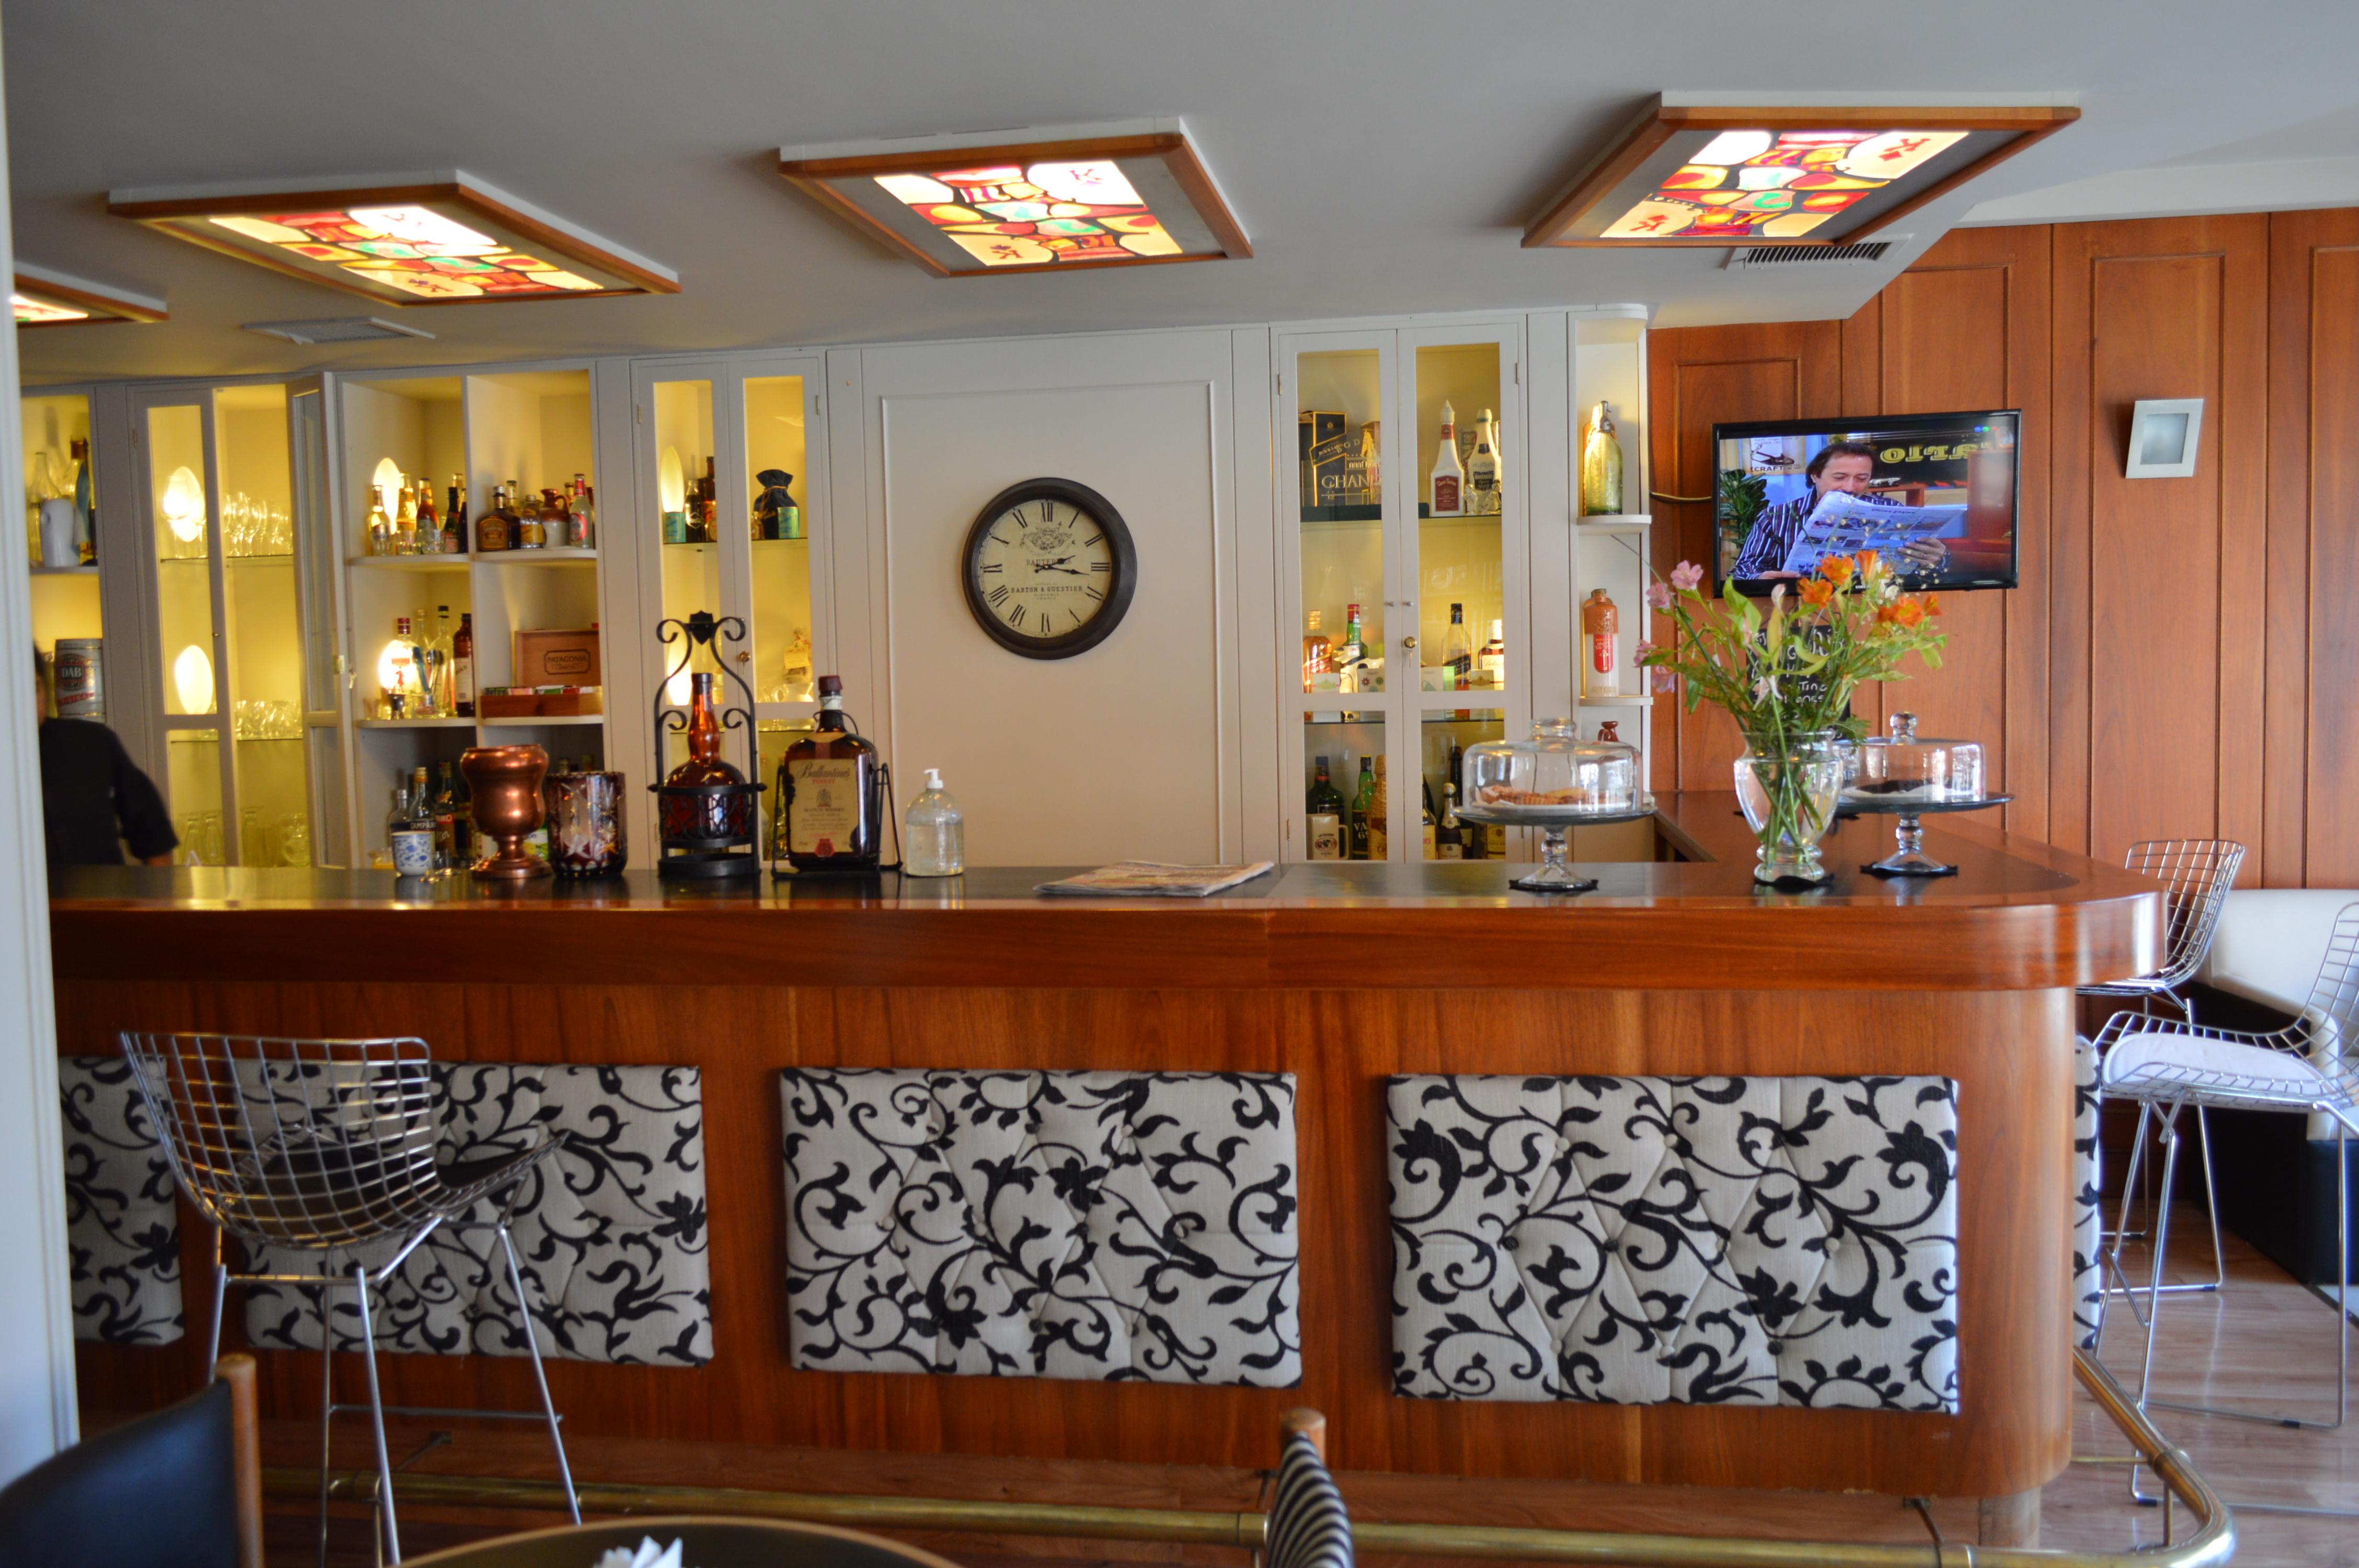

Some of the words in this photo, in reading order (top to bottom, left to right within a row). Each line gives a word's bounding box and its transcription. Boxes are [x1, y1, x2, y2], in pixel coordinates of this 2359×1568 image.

[1040, 502, 1053, 522] XII
[1012, 509, 1028, 529] XI
[1069, 511, 1080, 529] I
[1084, 533, 1104, 547] II
[983, 563, 1002, 573] IX
[1091, 562, 1110, 572] III
[61, 666, 82, 678] DAB
[1354, 822, 1367, 831] VA
